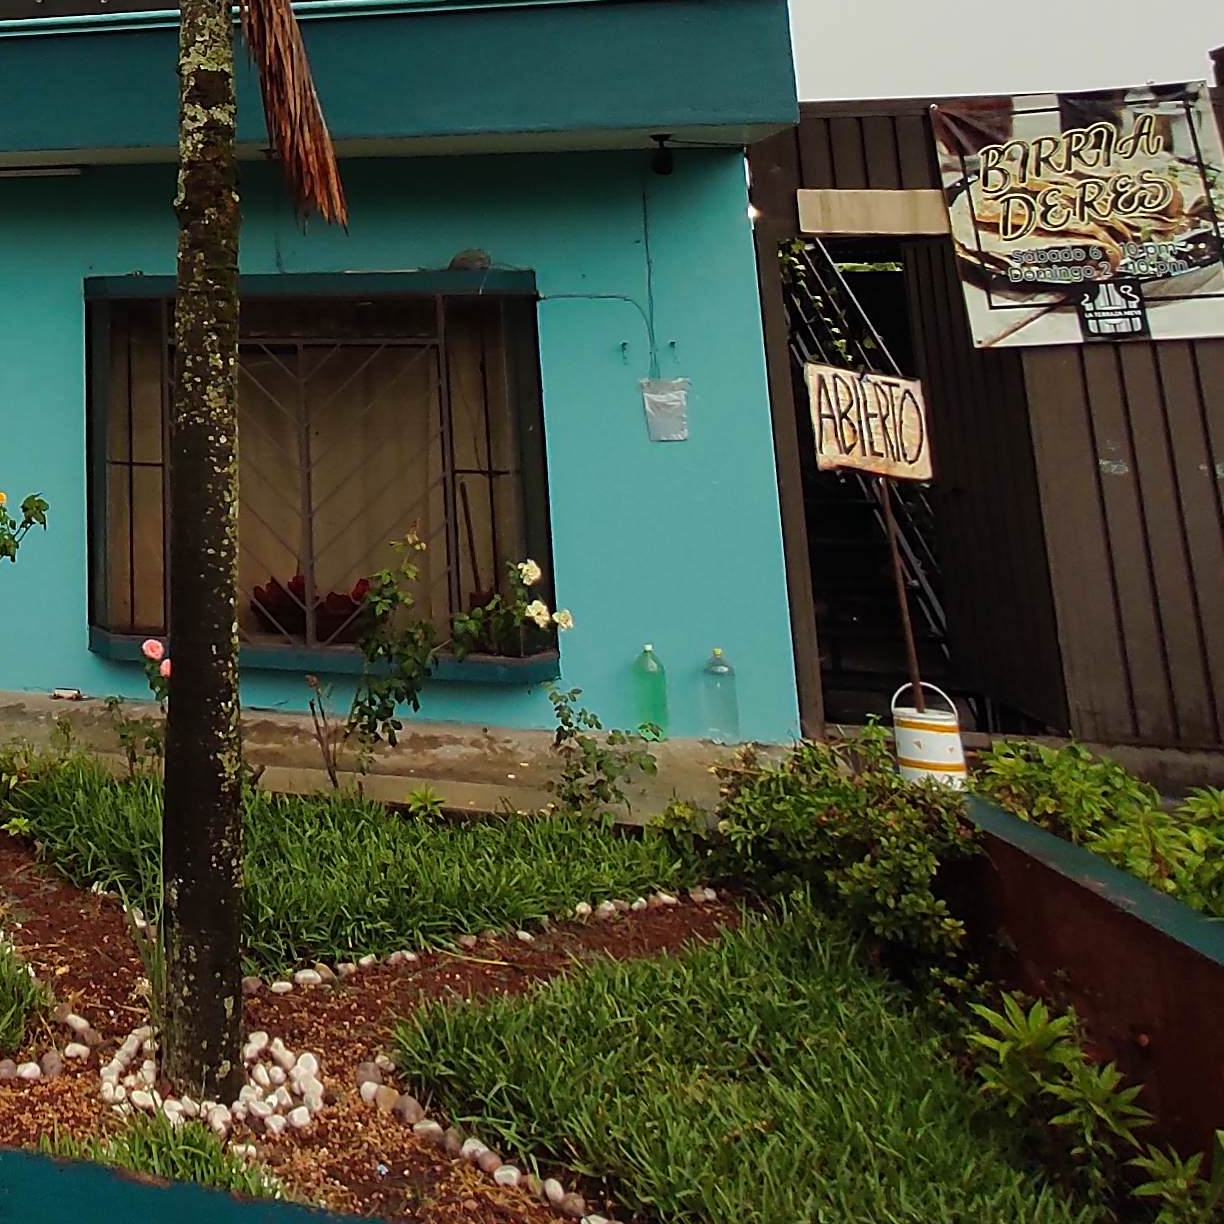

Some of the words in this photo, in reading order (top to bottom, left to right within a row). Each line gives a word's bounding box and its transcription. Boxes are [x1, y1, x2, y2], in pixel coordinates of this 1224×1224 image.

[979, 113, 1162, 194] BIRRIA
[999, 187, 1072, 241] DE
[1076, 169, 1173, 225] RES
[1008, 264, 1096, 283] Domingo
[1098, 260, 1112, 277] 2
[1154, 260, 1188, 276] pm
[1088, 245, 1103, 260] 6
[817, 373, 924, 465] ABIERTO
